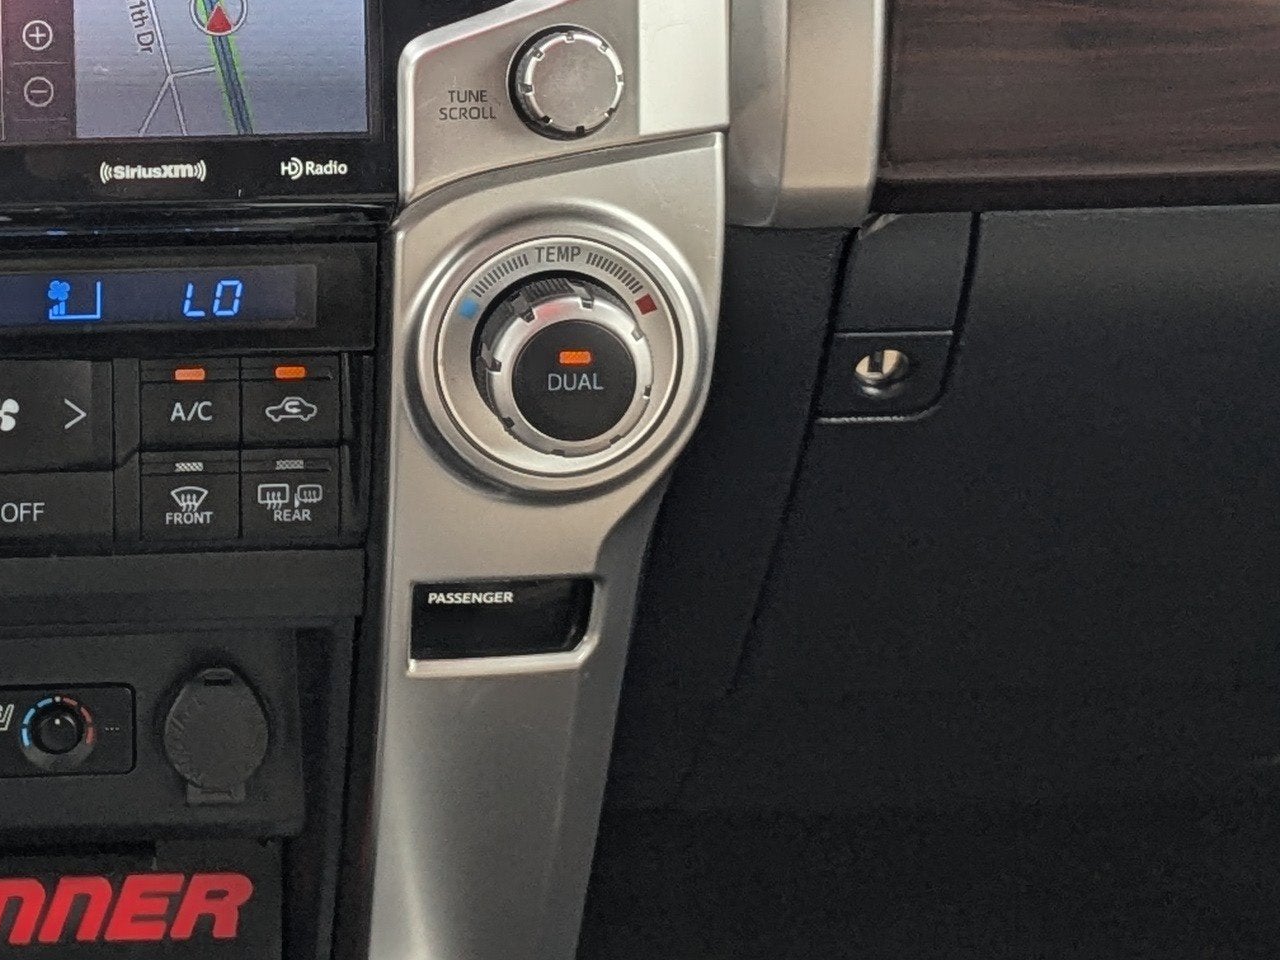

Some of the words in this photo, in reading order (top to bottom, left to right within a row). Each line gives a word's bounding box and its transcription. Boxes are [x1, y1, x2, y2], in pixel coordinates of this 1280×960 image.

[136, 30, 155, 54] Dr
[447, 89, 488, 104] TUNE
[438, 105, 497, 120] SCROLL
[305, 160, 348, 176] Radio
[534, 245, 582, 265] TEMP
[546, 373, 604, 393] DUAL
[170, 401, 213, 423] A/C
[0, 501, 46, 523] OFF
[165, 511, 213, 525] FRONT
[272, 508, 312, 522] REAR
[427, 590, 514, 605] PASSENGER
